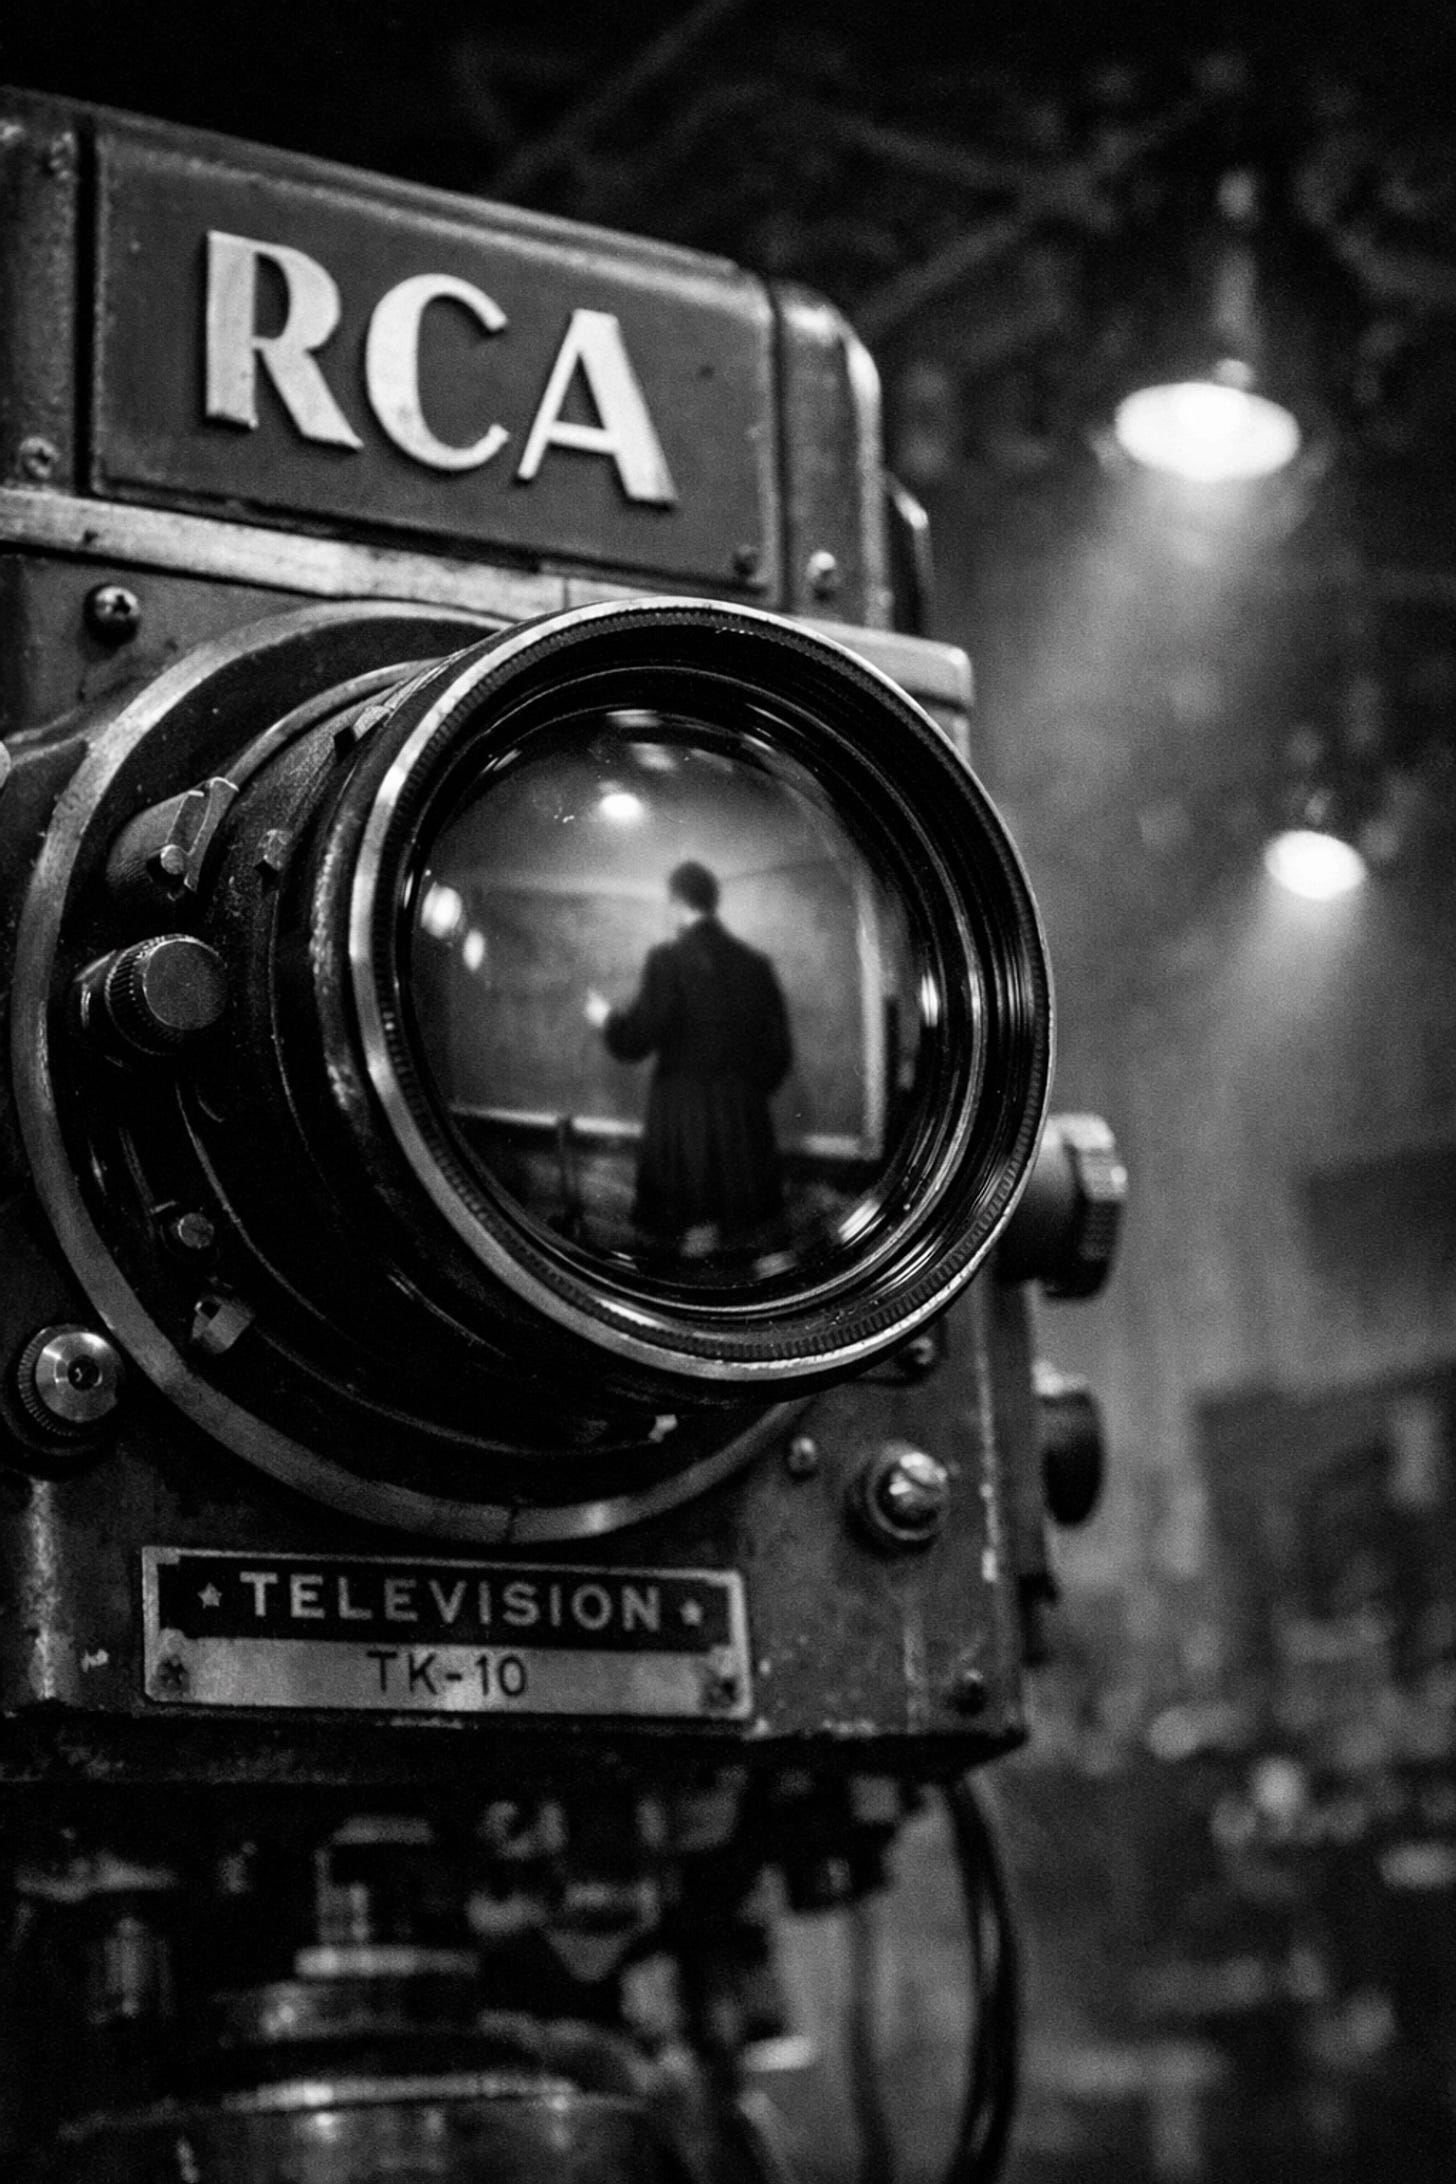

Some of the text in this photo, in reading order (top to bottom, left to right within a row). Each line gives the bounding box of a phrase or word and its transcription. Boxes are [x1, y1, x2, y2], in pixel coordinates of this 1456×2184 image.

[206, 229, 678, 504] RCA
[239, 1570, 661, 1631] TELEVISION
[366, 1649, 528, 1697] TK-10
